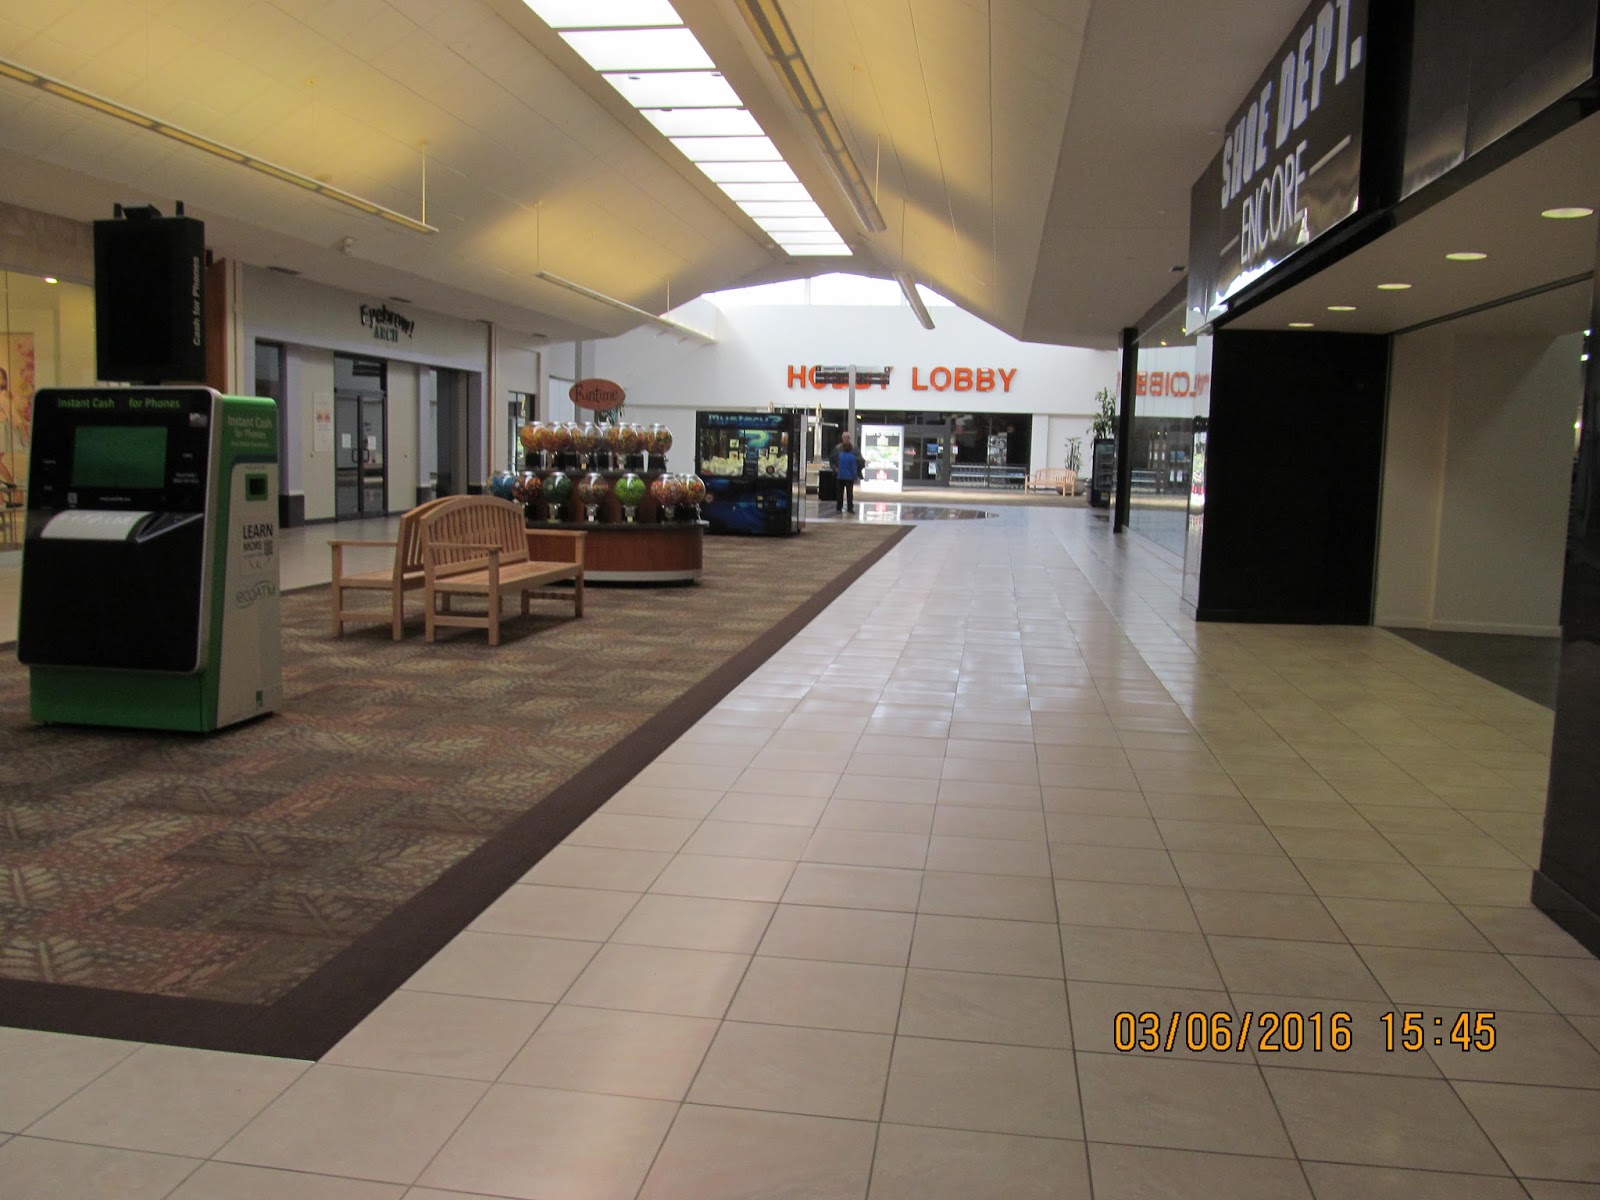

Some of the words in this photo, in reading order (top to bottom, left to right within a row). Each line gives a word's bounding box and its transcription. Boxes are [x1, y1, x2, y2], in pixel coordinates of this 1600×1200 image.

[1221, 80, 1272, 210] SHOE
[1275, 0, 1362, 150] DEPT.
[1240, 140, 1308, 265] ENCORE
[192, 299, 200, 316] for
[192, 317, 200, 346] Cash
[374, 325, 398, 342] ARCH
[911, 366, 1017, 392] LOBBY
[58, 398, 90, 409] Instant
[92, 398, 115, 409] Cash
[129, 398, 142, 409] for
[145, 398, 181, 409] Phones
[243, 523, 273, 539] LEARN
[243, 541, 263, 552] MORE
